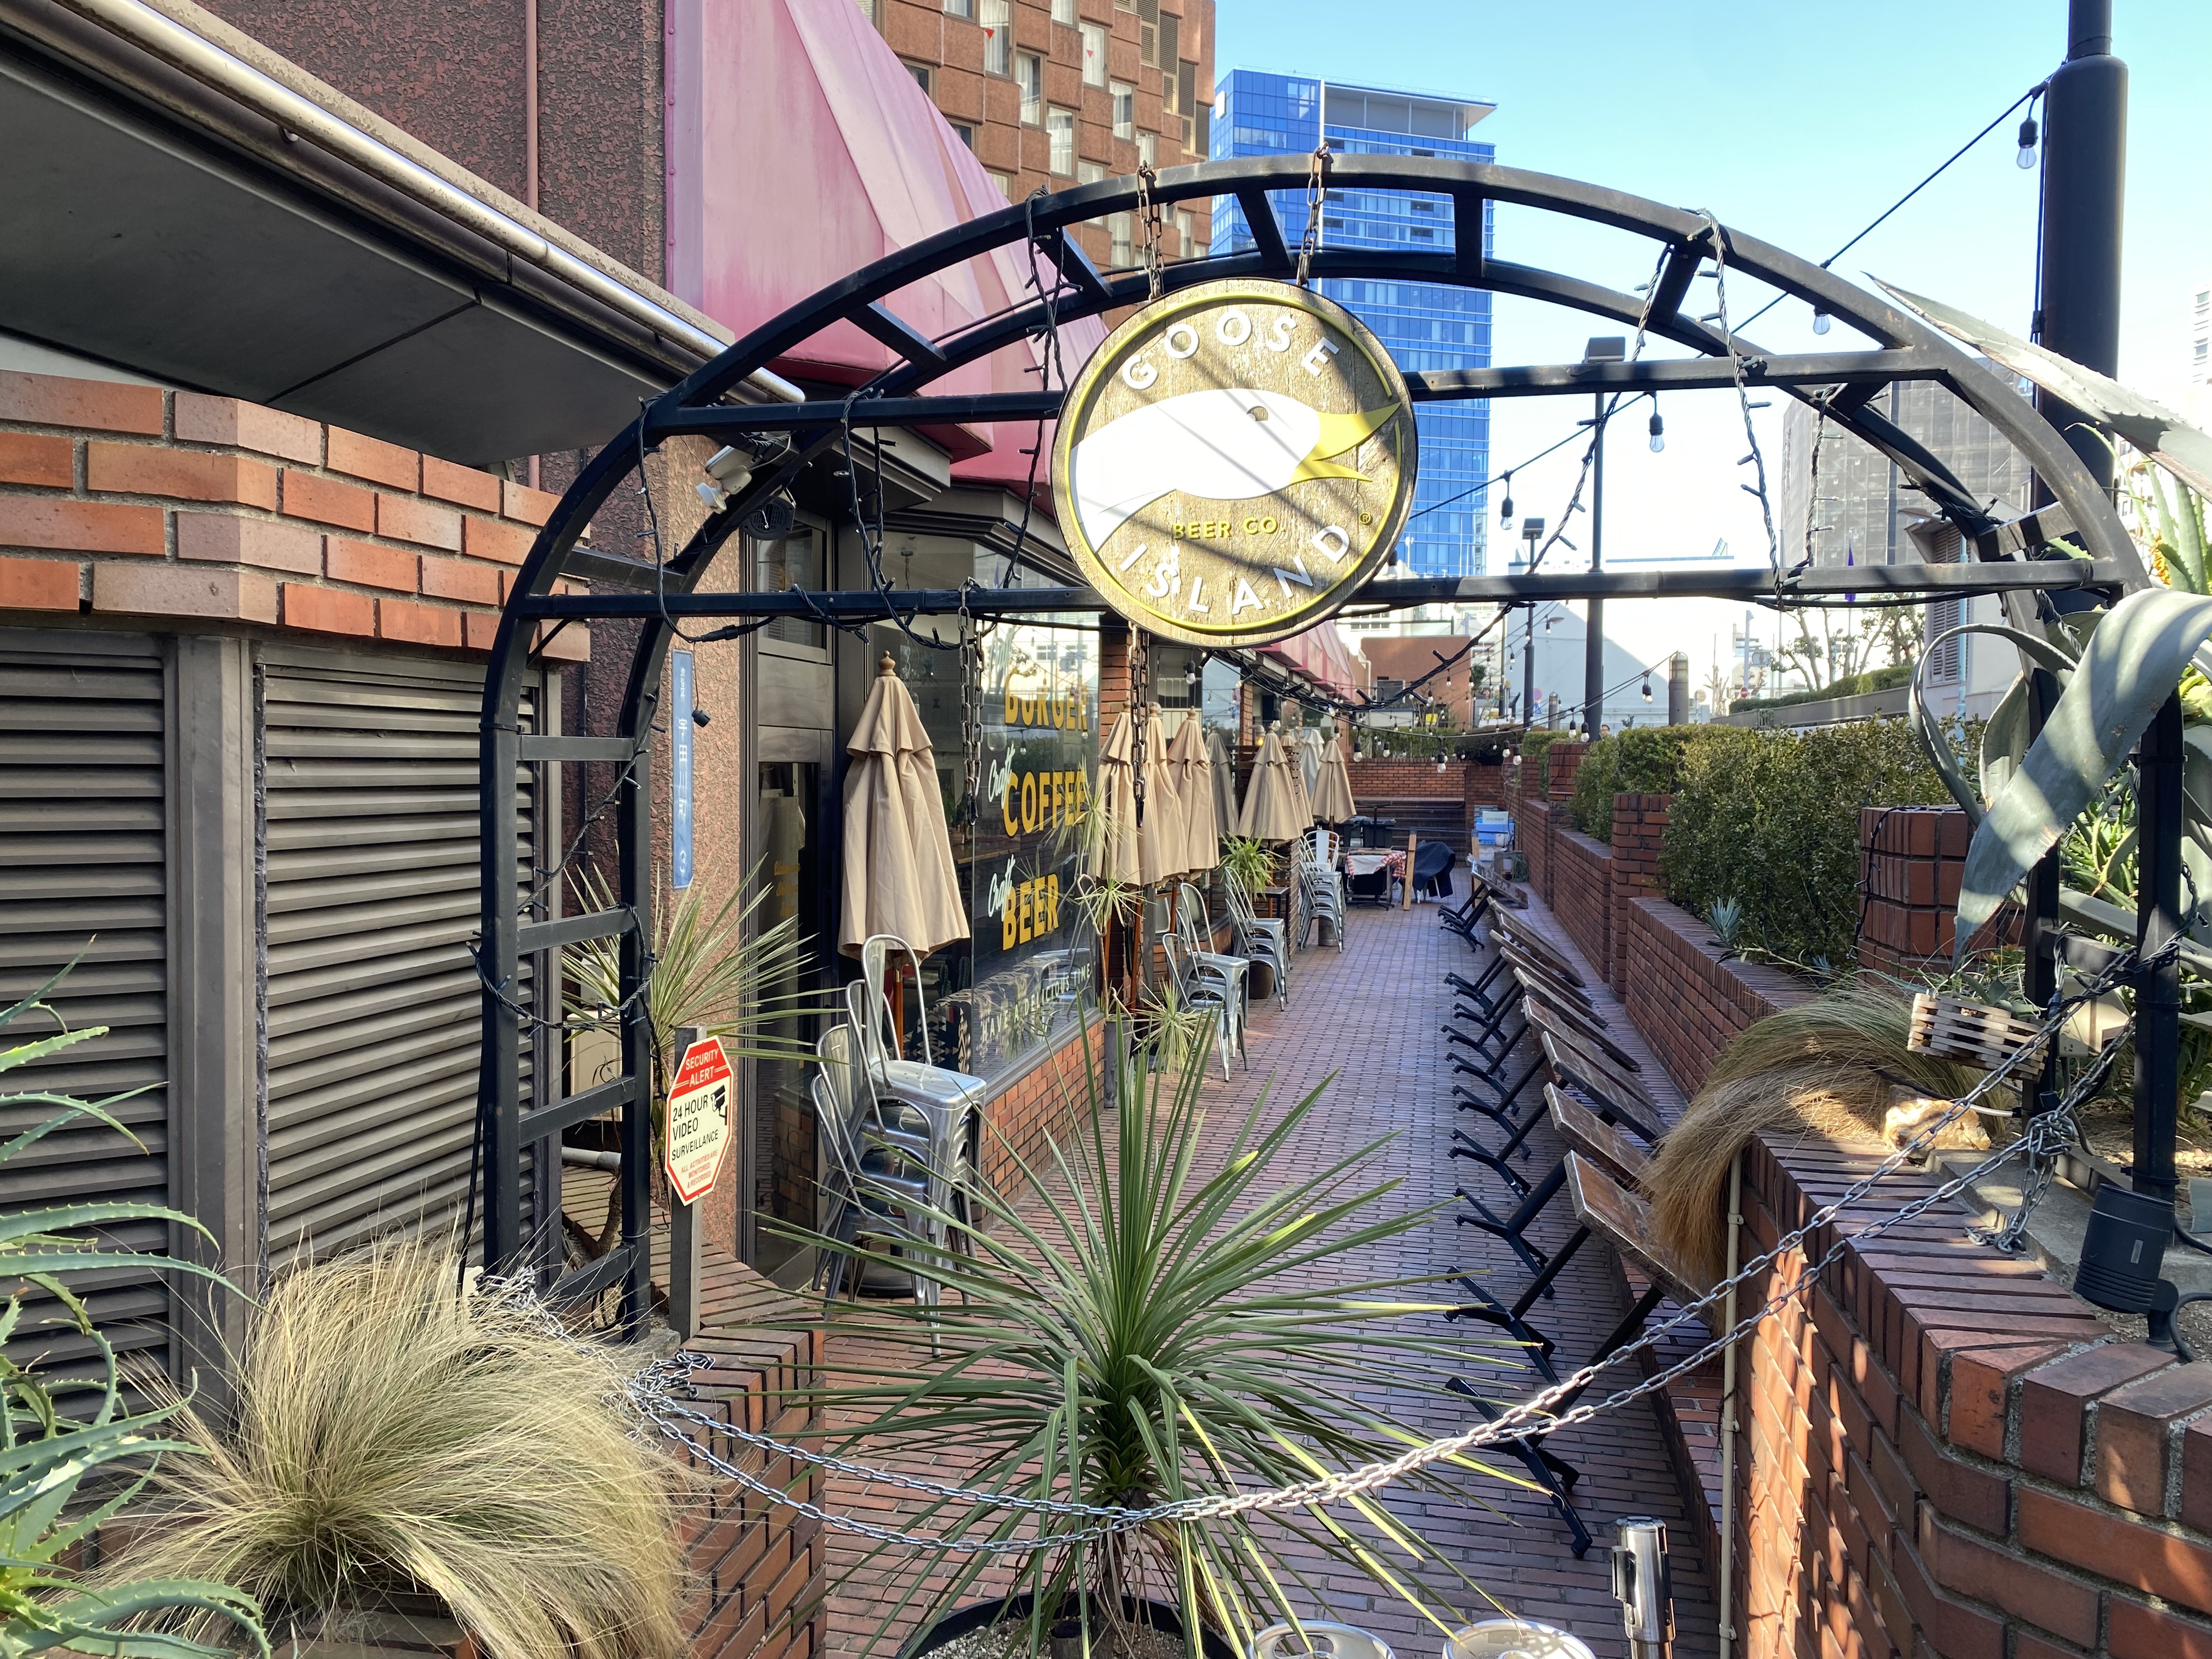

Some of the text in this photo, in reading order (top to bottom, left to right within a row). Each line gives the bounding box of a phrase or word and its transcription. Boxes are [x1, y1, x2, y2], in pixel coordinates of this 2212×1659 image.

[1122, 309, 1340, 390] GOOSE
[1172, 520, 1232, 540] BEER
[1119, 524, 1350, 614] ISLAND
[988, 742, 1015, 810] Craft
[1003, 771, 1086, 837] COFFEE
[988, 854, 1015, 922] Craft
[1003, 873, 1059, 951] BEER
[982, 1009, 1008, 1041] HAVE
[1014, 1005, 1019, 1023] A
[1024, 975, 1069, 1016] DELICIOUS
[686, 1048, 720, 1070] SECURITY
[689, 1066, 714, 1087] ALERT
[673, 1094, 708, 1122] 24 HOUR
[673, 1117, 698, 1141] VIDEO
[672, 1129, 719, 1161] SURVEILLANCE
